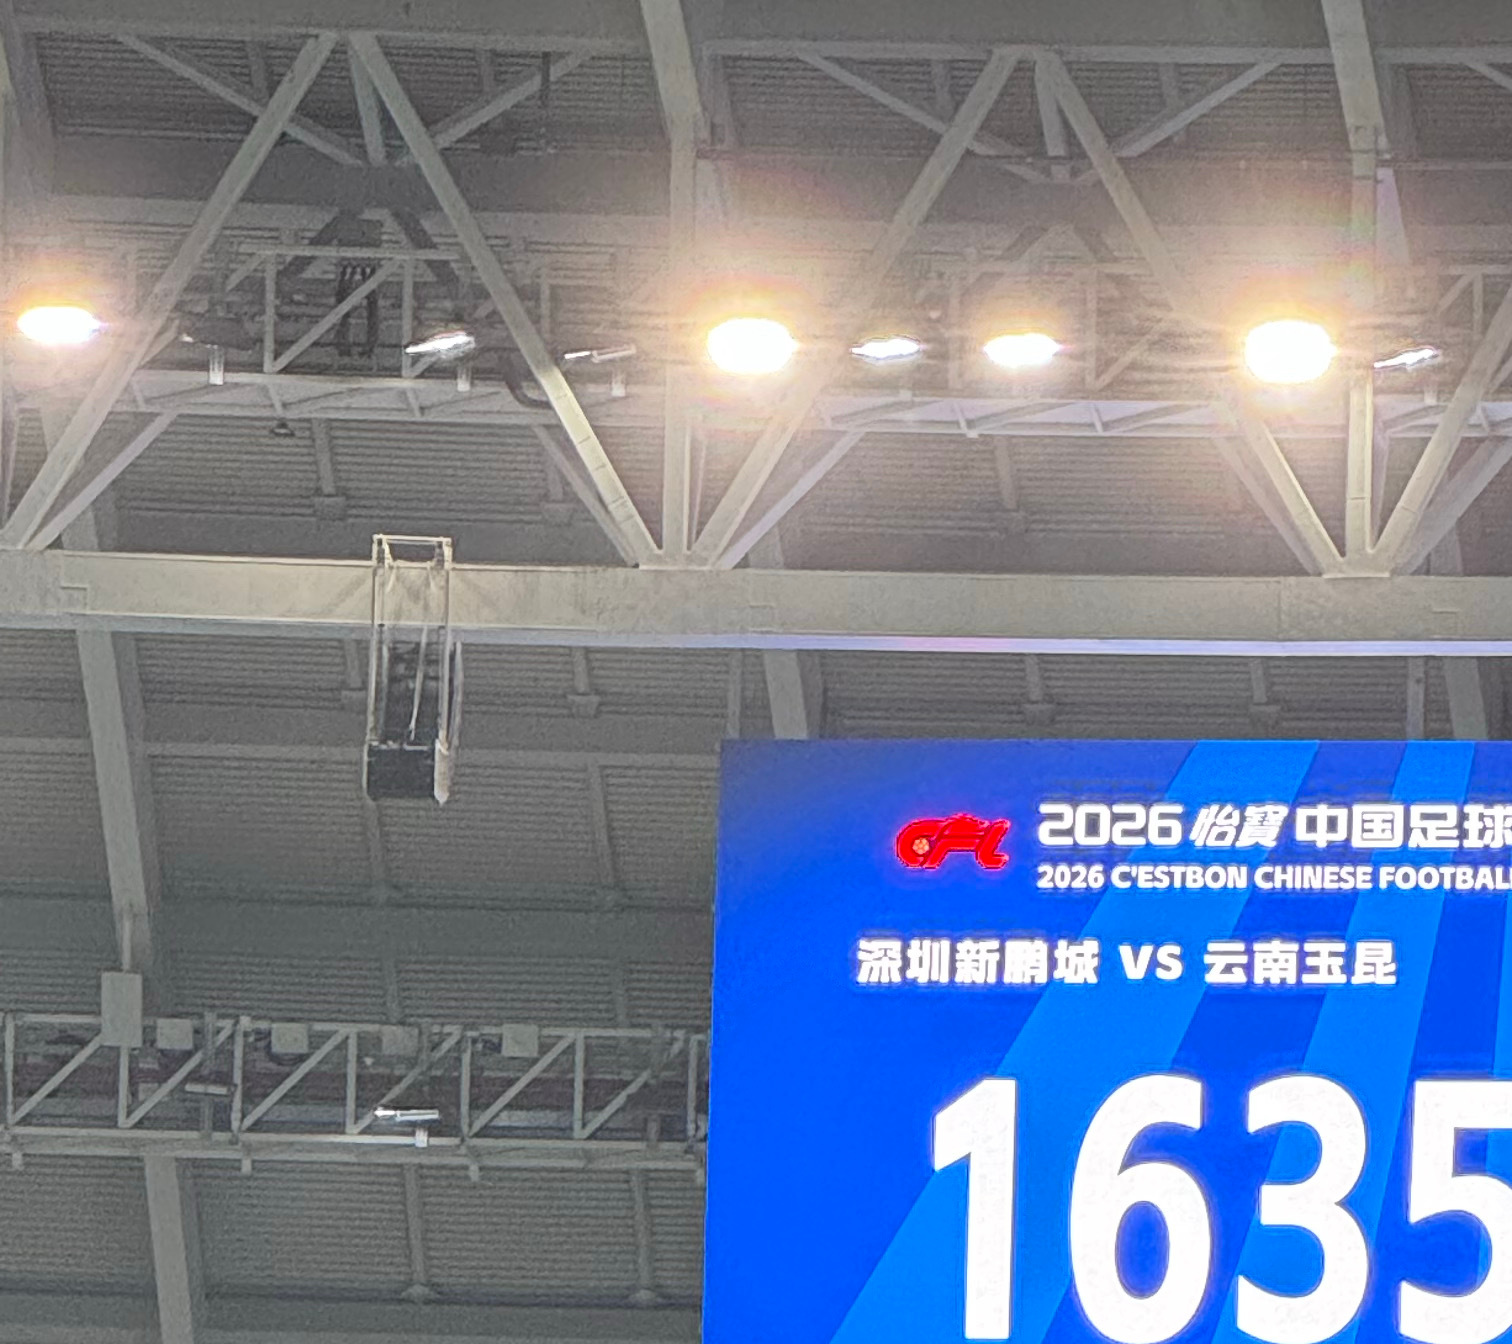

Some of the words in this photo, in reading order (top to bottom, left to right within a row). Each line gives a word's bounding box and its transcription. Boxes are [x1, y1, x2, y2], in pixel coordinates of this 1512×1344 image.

[1036, 863, 1104, 889] 2026
[1111, 864, 1247, 889] C'ESTBON
[1254, 865, 1373, 890] CHINESE
[857, 938, 1099, 984] 深圳新鹏城
[1119, 945, 1182, 979] VS
[1204, 940, 1397, 984] 云南玉昆
